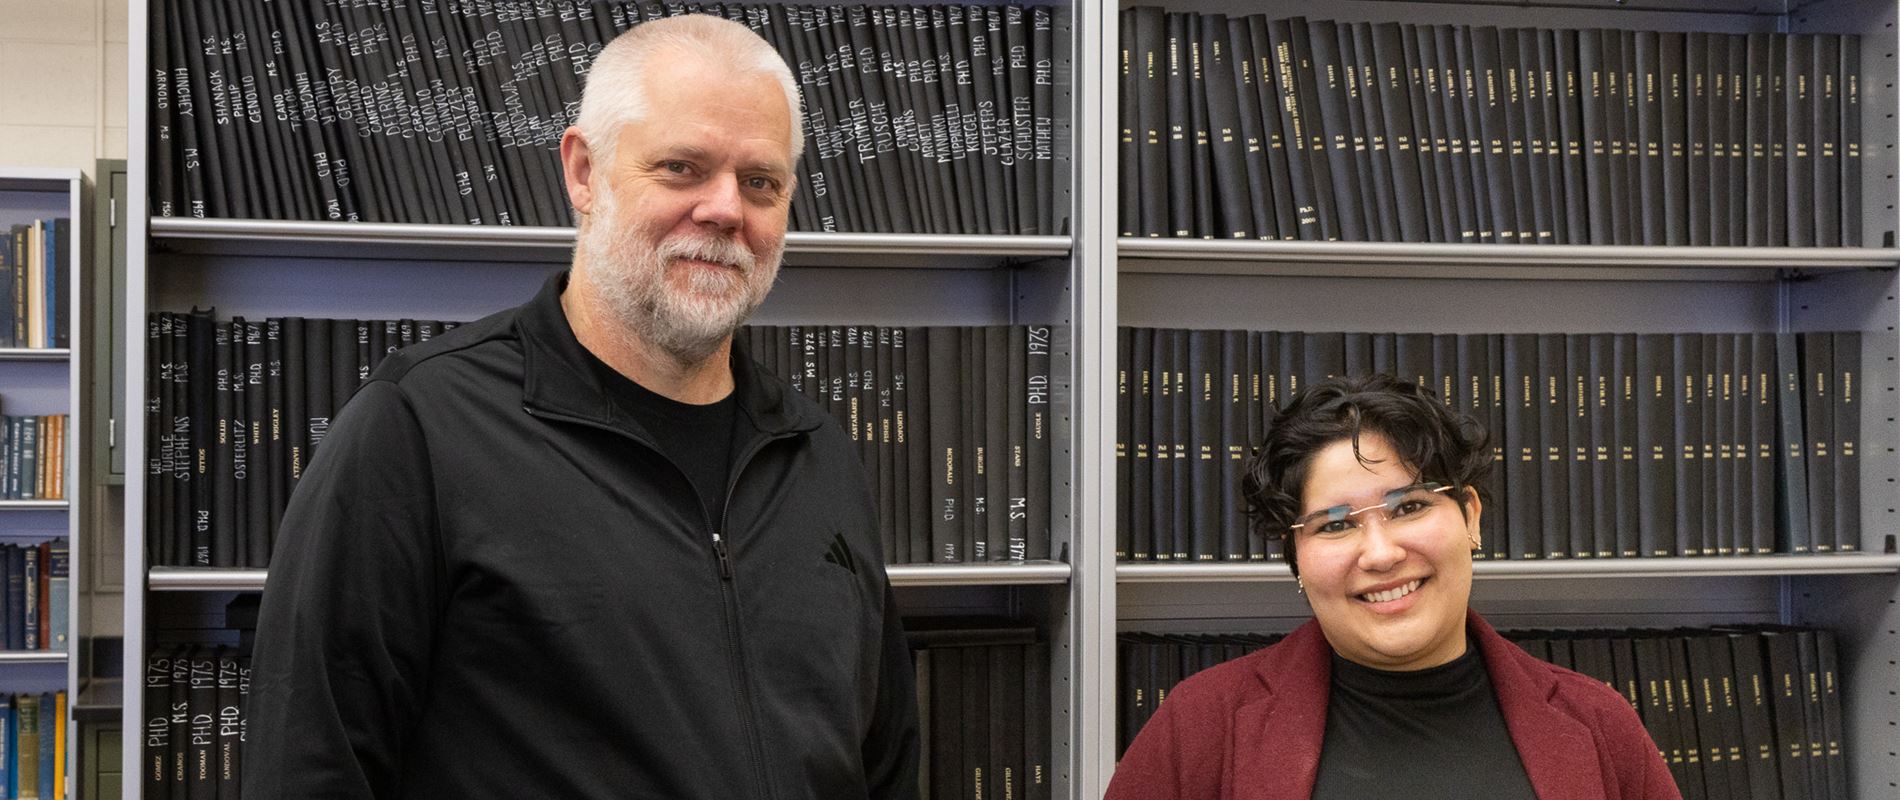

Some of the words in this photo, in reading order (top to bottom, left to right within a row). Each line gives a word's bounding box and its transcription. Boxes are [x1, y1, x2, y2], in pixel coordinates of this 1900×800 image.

[545, 33, 567, 62] PH.D.
[155, 69, 168, 110] ARNOLD
[209, 70, 229, 125] SHANACK
[228, 84, 244, 118] PHILIP
[242, 75, 262, 123] GENOLIO
[273, 94, 288, 121] CANO
[283, 88, 303, 132] TAYLOR
[326, 67, 353, 120] GENTRY
[361, 85, 382, 133] CANFIELD
[373, 81, 401, 136] DEERING
[462, 86, 483, 127] PEARCE
[408, 104, 425, 132] GRAY
[416, 88, 443, 143] GENOLIO
[446, 86, 474, 142] PELTZER
[492, 111, 516, 148] LANEY
[501, 79, 534, 147] RANDHAWA
[810, 107, 832, 159] MITCHELL
[840, 117, 855, 144] WU
[849, 97, 876, 164] TRIMMIER
[870, 101, 894, 153] RUSCHE
[903, 109, 920, 151] COLLINS
[945, 103, 966, 160] LIPPARELLI
[962, 111, 980, 152] KREGEL
[979, 100, 998, 155] JEFFERS
[1014, 96, 1034, 160] SCHUSTER
[175, 67, 194, 117] HINCHEY
[192, 200, 204, 218] 1957
[295, 72, 318, 122] HINCHEY
[327, 199, 341, 219] 1960
[917, 123, 935, 158] ARNETT
[997, 118, 1014, 166] GLAZER
[1036, 117, 1051, 160] MATHEW
[810, 171, 826, 198] PH.D.
[806, 332, 815, 355] 1972
[1028, 325, 1049, 355] 1975
[1027, 375, 1048, 404] PH.D.
[151, 458, 161, 475] WEI
[234, 419, 247, 480] OSTERLITZ
[1010, 497, 1026, 522] M.S.
[147, 658, 170, 688] 1975
[173, 659, 188, 683] 1975
[190, 660, 215, 689] 1975
[218, 658, 238, 689] 1975
[192, 713, 214, 745] PH.D.
